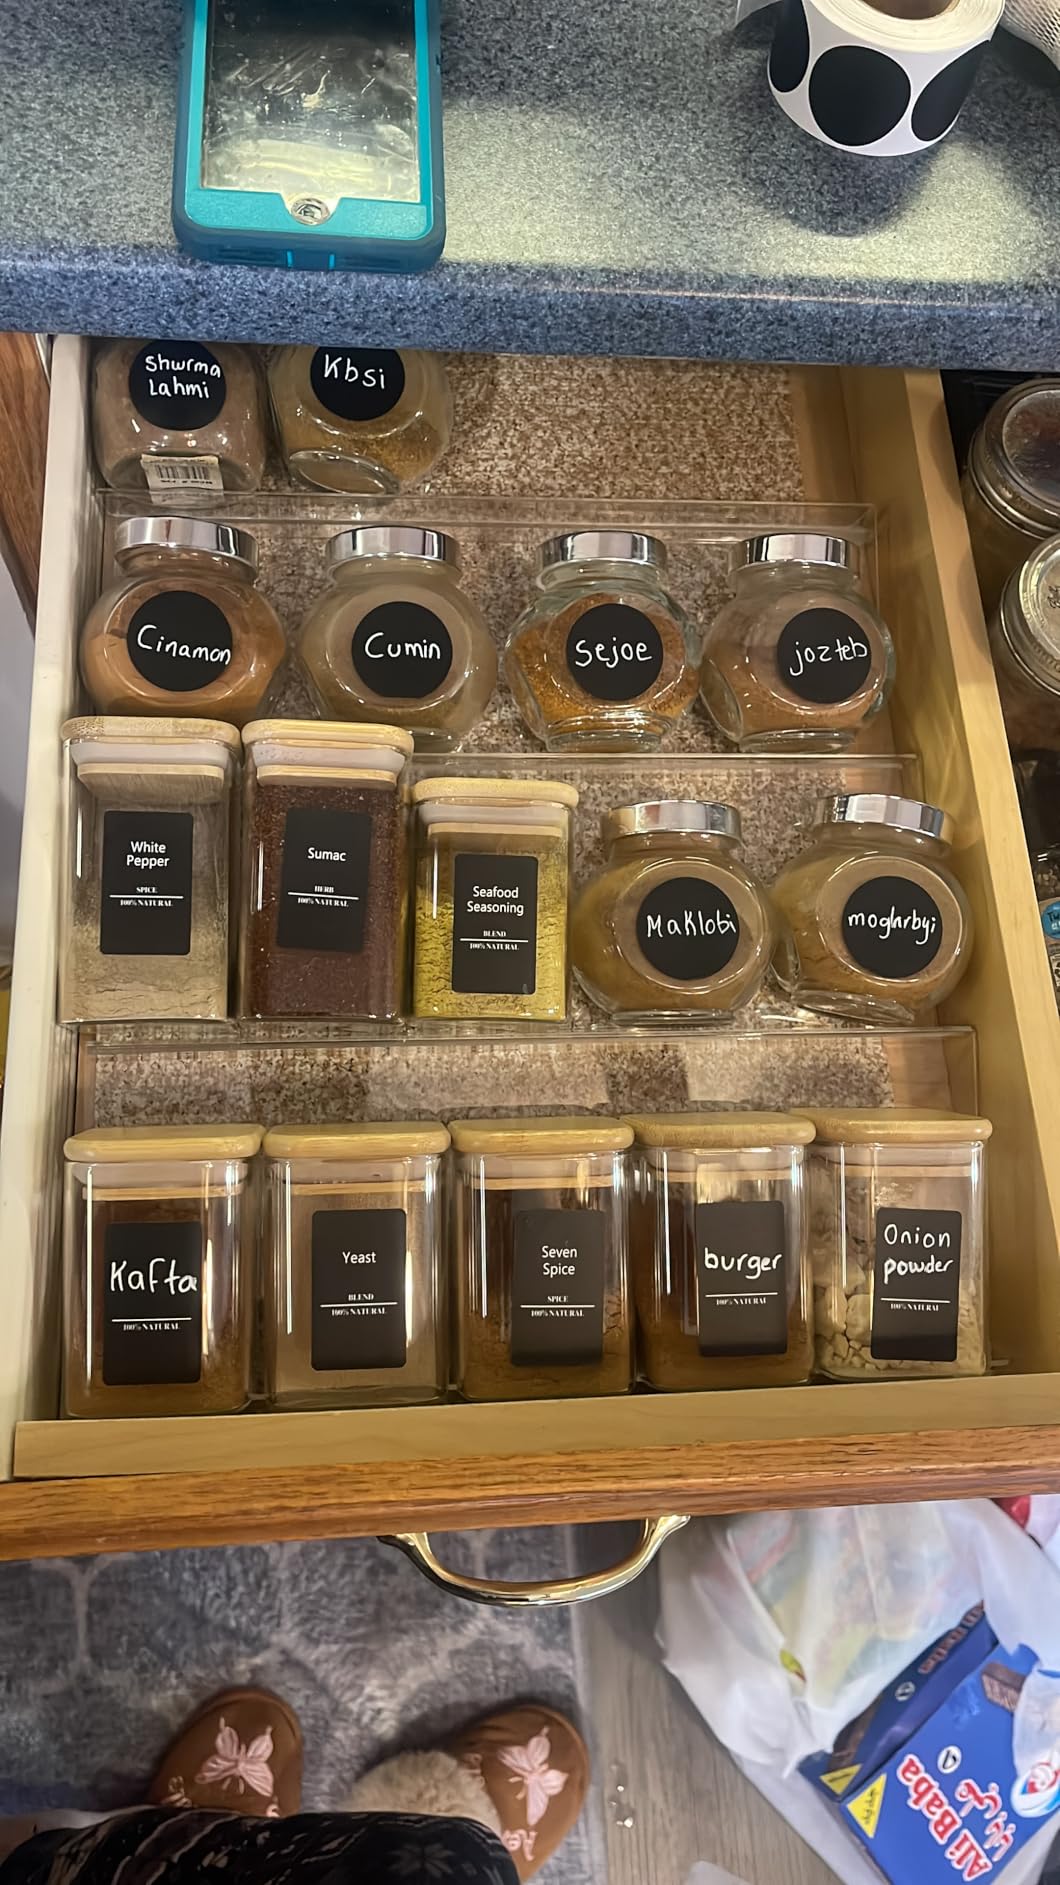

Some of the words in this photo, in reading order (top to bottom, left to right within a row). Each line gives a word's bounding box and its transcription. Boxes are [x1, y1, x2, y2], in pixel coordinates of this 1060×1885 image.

[324, 354, 386, 389] Kbsi
[149, 375, 210, 399] Lahmi
[137, 624, 232, 665] Cinamon
[364, 632, 441, 660] Cumin
[575, 636, 653, 669] Sejoe
[130, 840, 167, 854] White
[307, 847, 347, 862] Sumac
[126, 854, 170, 870] Pepper
[136, 886, 158, 894] SPICE
[314, 885, 335, 894] HERB
[472, 885, 519, 899] Seafood
[137, 899, 173, 907] NATURAL
[314, 897, 349, 908] NATURAL
[466, 900, 524, 917] Seasoning
[483, 930, 507, 938] BLEND
[486, 942, 520, 951] NATURAL
[884, 1223, 951, 1249] Onion
[342, 1251, 377, 1264] Yeast
[541, 1245, 578, 1259] Seven
[542, 1262, 576, 1279] Spice
[704, 1248, 783, 1280] burger
[883, 1254, 954, 1285] powder
[348, 1293, 375, 1301] BLEND
[547, 1295, 569, 1303] SPICE
[349, 1306, 387, 1316] NATURAL
[549, 1309, 585, 1317] NATURAL
[142, 1322, 180, 1331] NATURAL
[898, 1755, 962, 1844] Baba
[945, 1829, 992, 1880] Ali
